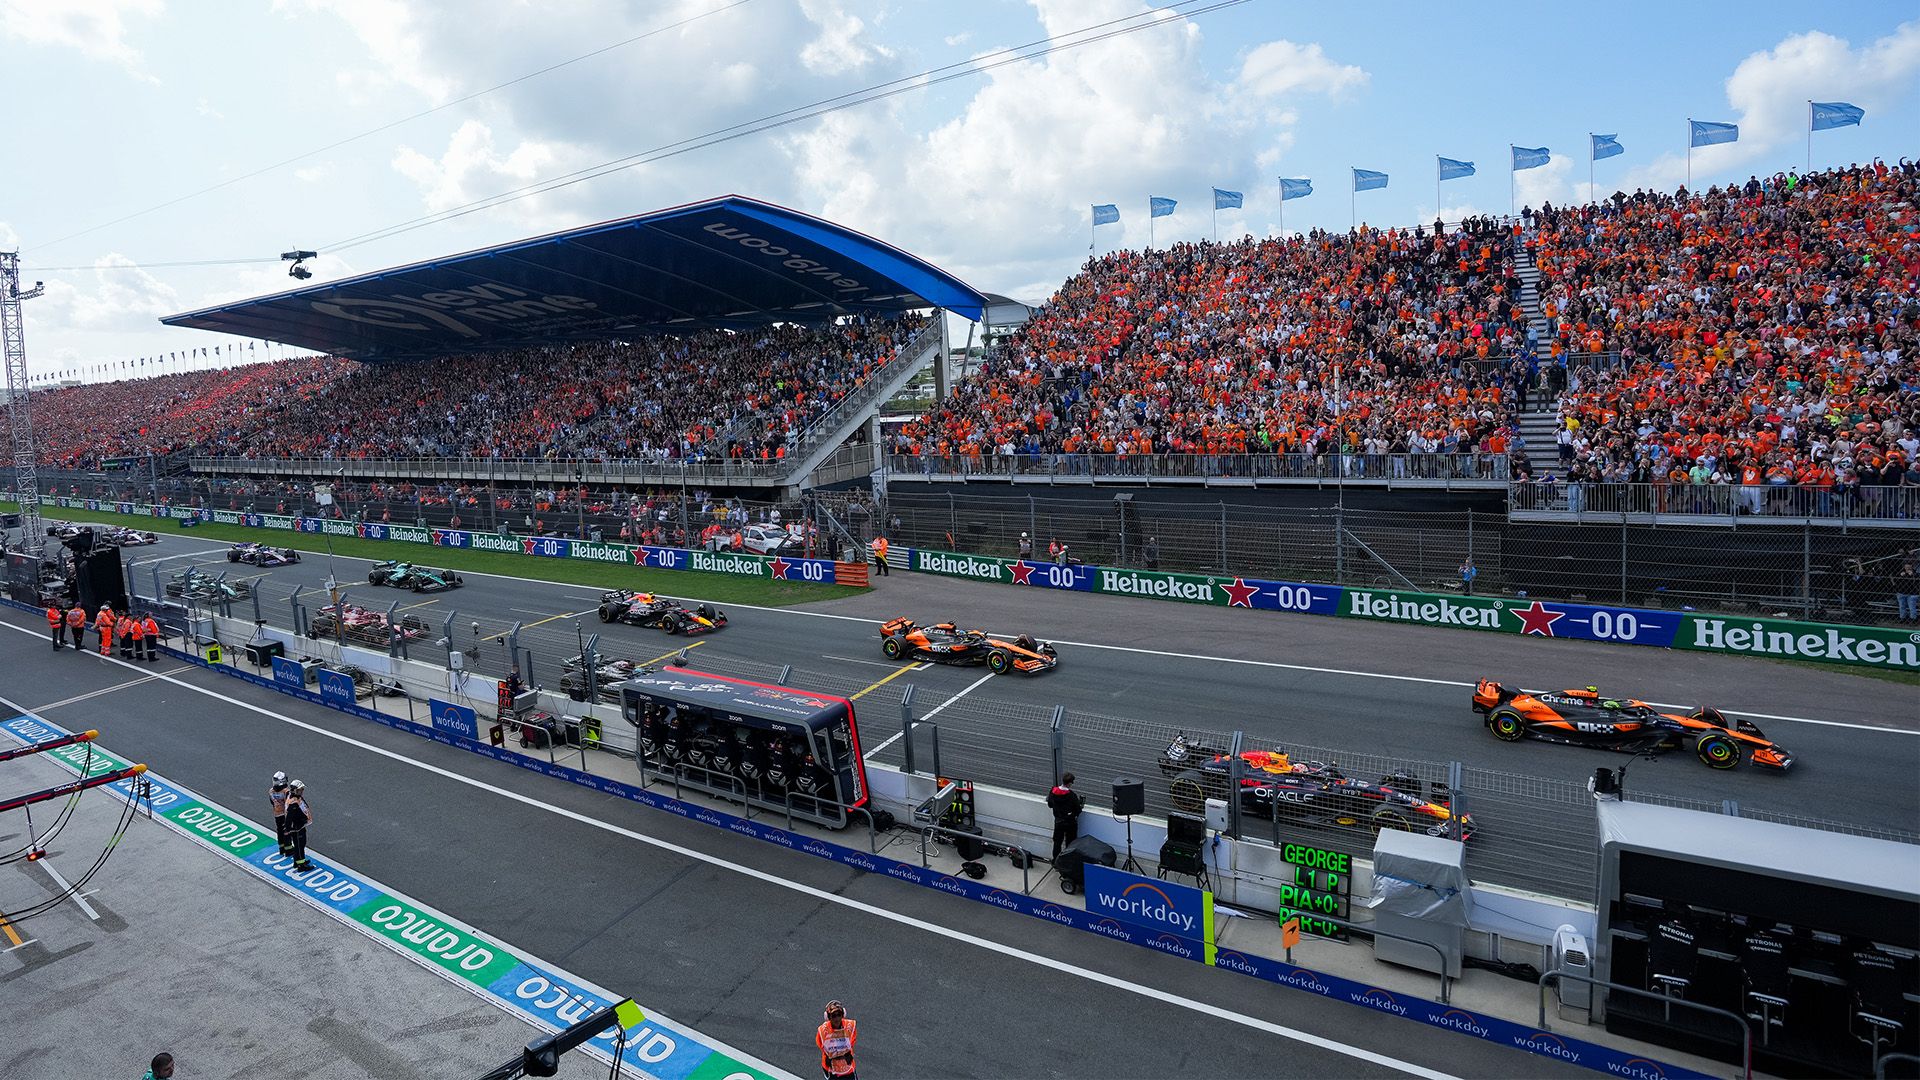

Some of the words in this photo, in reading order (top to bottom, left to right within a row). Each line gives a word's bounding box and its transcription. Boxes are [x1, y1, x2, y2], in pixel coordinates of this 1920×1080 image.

[213, 511, 239, 524] Heineken
[263, 516, 293, 529] Heineken
[322, 521, 355, 536] Heineken
[389, 527, 429, 544] Heineken
[449, 533, 461, 546] 0.0
[472, 534, 519, 552] Heineken
[543, 540, 558, 556] 0.0
[571, 542, 628, 562] Heineken
[658, 550, 675, 567] 0.0
[692, 552, 764, 576] Heineken
[802, 562, 823, 581] 0.0
[919, 552, 1002, 579] Heineken
[1049, 566, 1075, 588] 0.0
[1101, 570, 1214, 601] Heineken
[1278, 586, 1311, 610] 0.0
[1350, 592, 1501, 629] Heineken
[1591, 611, 1638, 641] 0.0
[1693, 618, 1920, 667] Heineken
[276, 670, 301, 685] workday
[323, 684, 350, 699] workday
[1541, 693, 1584, 706] Chrome
[435, 715, 471, 735] workday
[772, 723, 787, 731] zoom
[53, 782, 82, 792] ORACLE
[1254, 788, 1314, 803] ORACLE
[178, 807, 258, 848] aramco
[414, 728, 430, 738] workday
[434, 735, 451, 745] workday
[455, 741, 472, 751] workday
[477, 748, 495, 758] workday
[500, 754, 518, 765] workday
[523, 761, 543, 772] workday
[549, 769, 569, 780] workday
[576, 776, 597, 788] workday
[604, 784, 626, 797] workday
[633, 793, 656, 807] workday
[663, 803, 687, 816] workday
[696, 812, 721, 827] workday
[730, 822, 757, 836] workday
[763, 832, 793, 848] workday
[802, 842, 833, 859] workday
[843, 854, 876, 871] workday
[887, 867, 921, 884] workday
[931, 878, 967, 896] workday
[980, 892, 1019, 910] workday
[1032, 907, 1073, 925] workday
[1088, 921, 1131, 940] workday
[1146, 936, 1193, 958] workday
[1284, 844, 1348, 873] GEORGE
[1098, 892, 1196, 931] workday
[371, 905, 494, 971] aramco
[1659, 924, 1694, 940] PETRONAS
[1745, 937, 1783, 949] PETRONAS
[1278, 973, 1330, 994] workday
[1351, 992, 1408, 1015] workday
[1428, 1013, 1490, 1037] workday
[1514, 1036, 1581, 1062] workday
